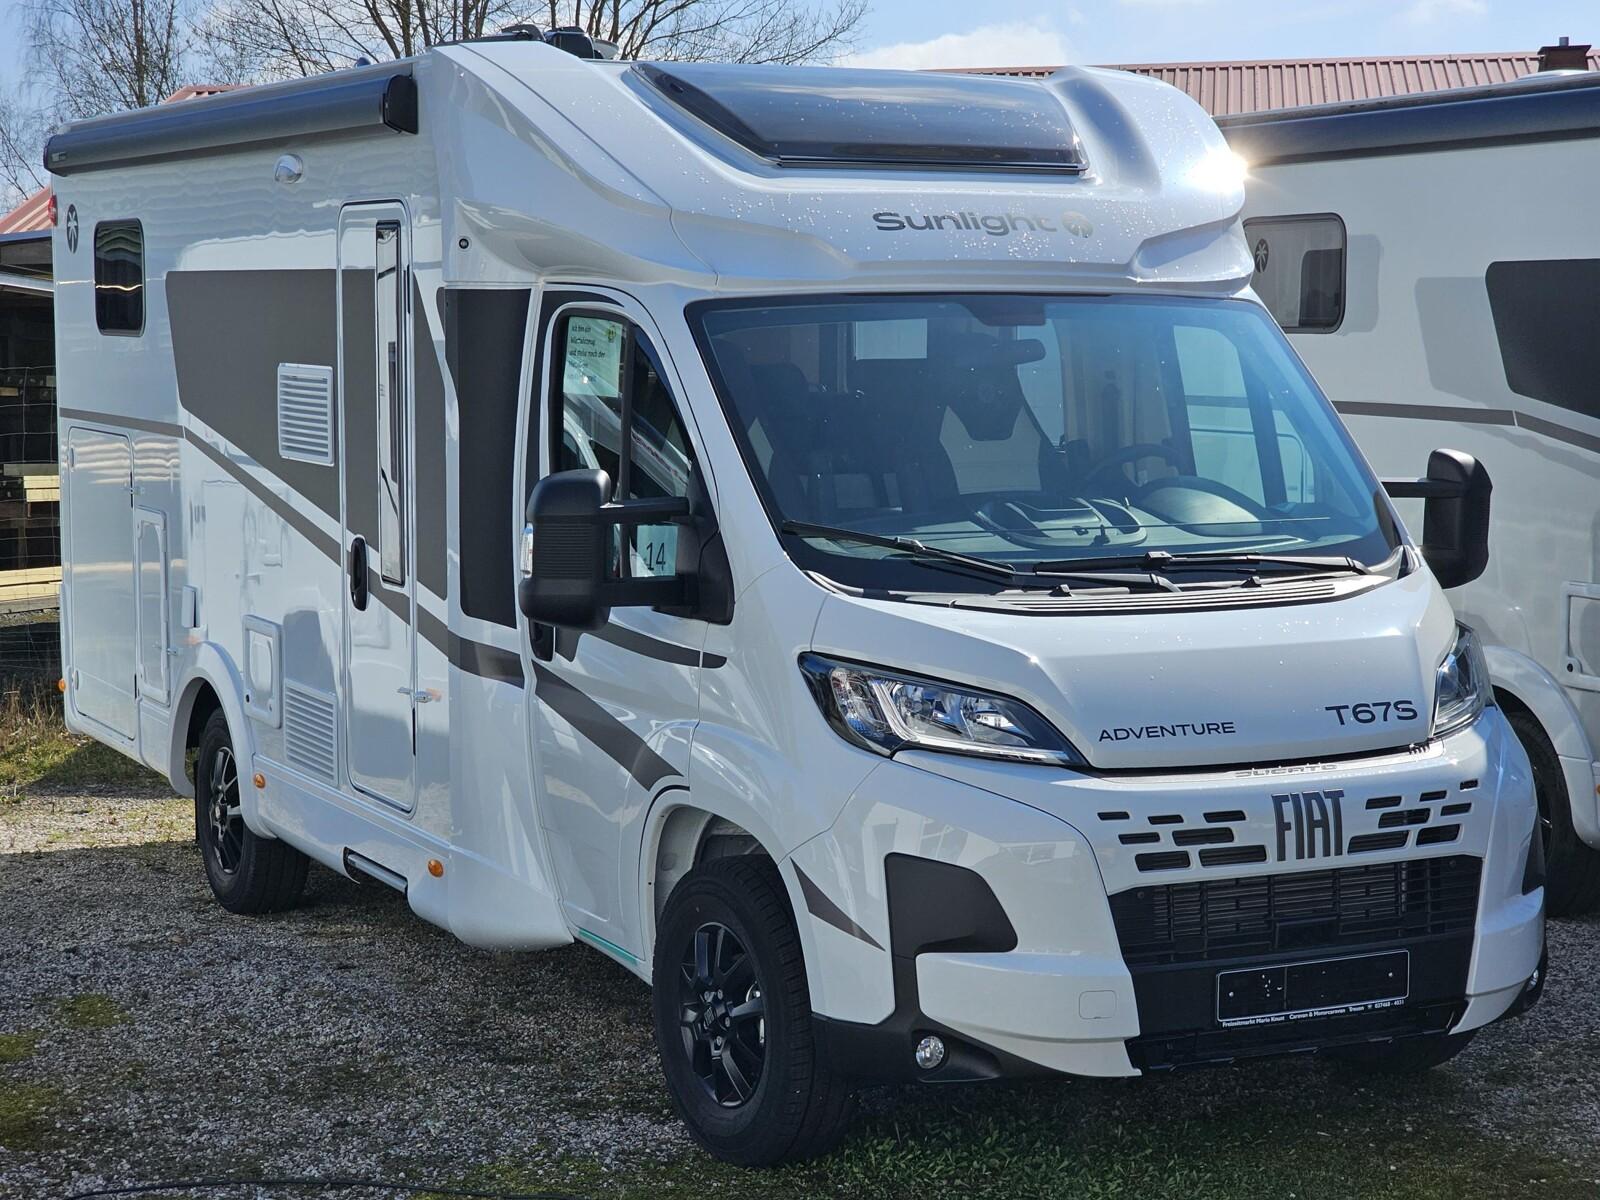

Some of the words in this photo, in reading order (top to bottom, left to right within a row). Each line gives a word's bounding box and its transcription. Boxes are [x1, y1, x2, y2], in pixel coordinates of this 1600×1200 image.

[872, 211, 1057, 237] Sunlight
[646, 541, 666, 572] 14
[1325, 700, 1418, 726] T67S
[1099, 721, 1236, 742] ADVENTURE
[1271, 788, 1345, 862] FIAT
